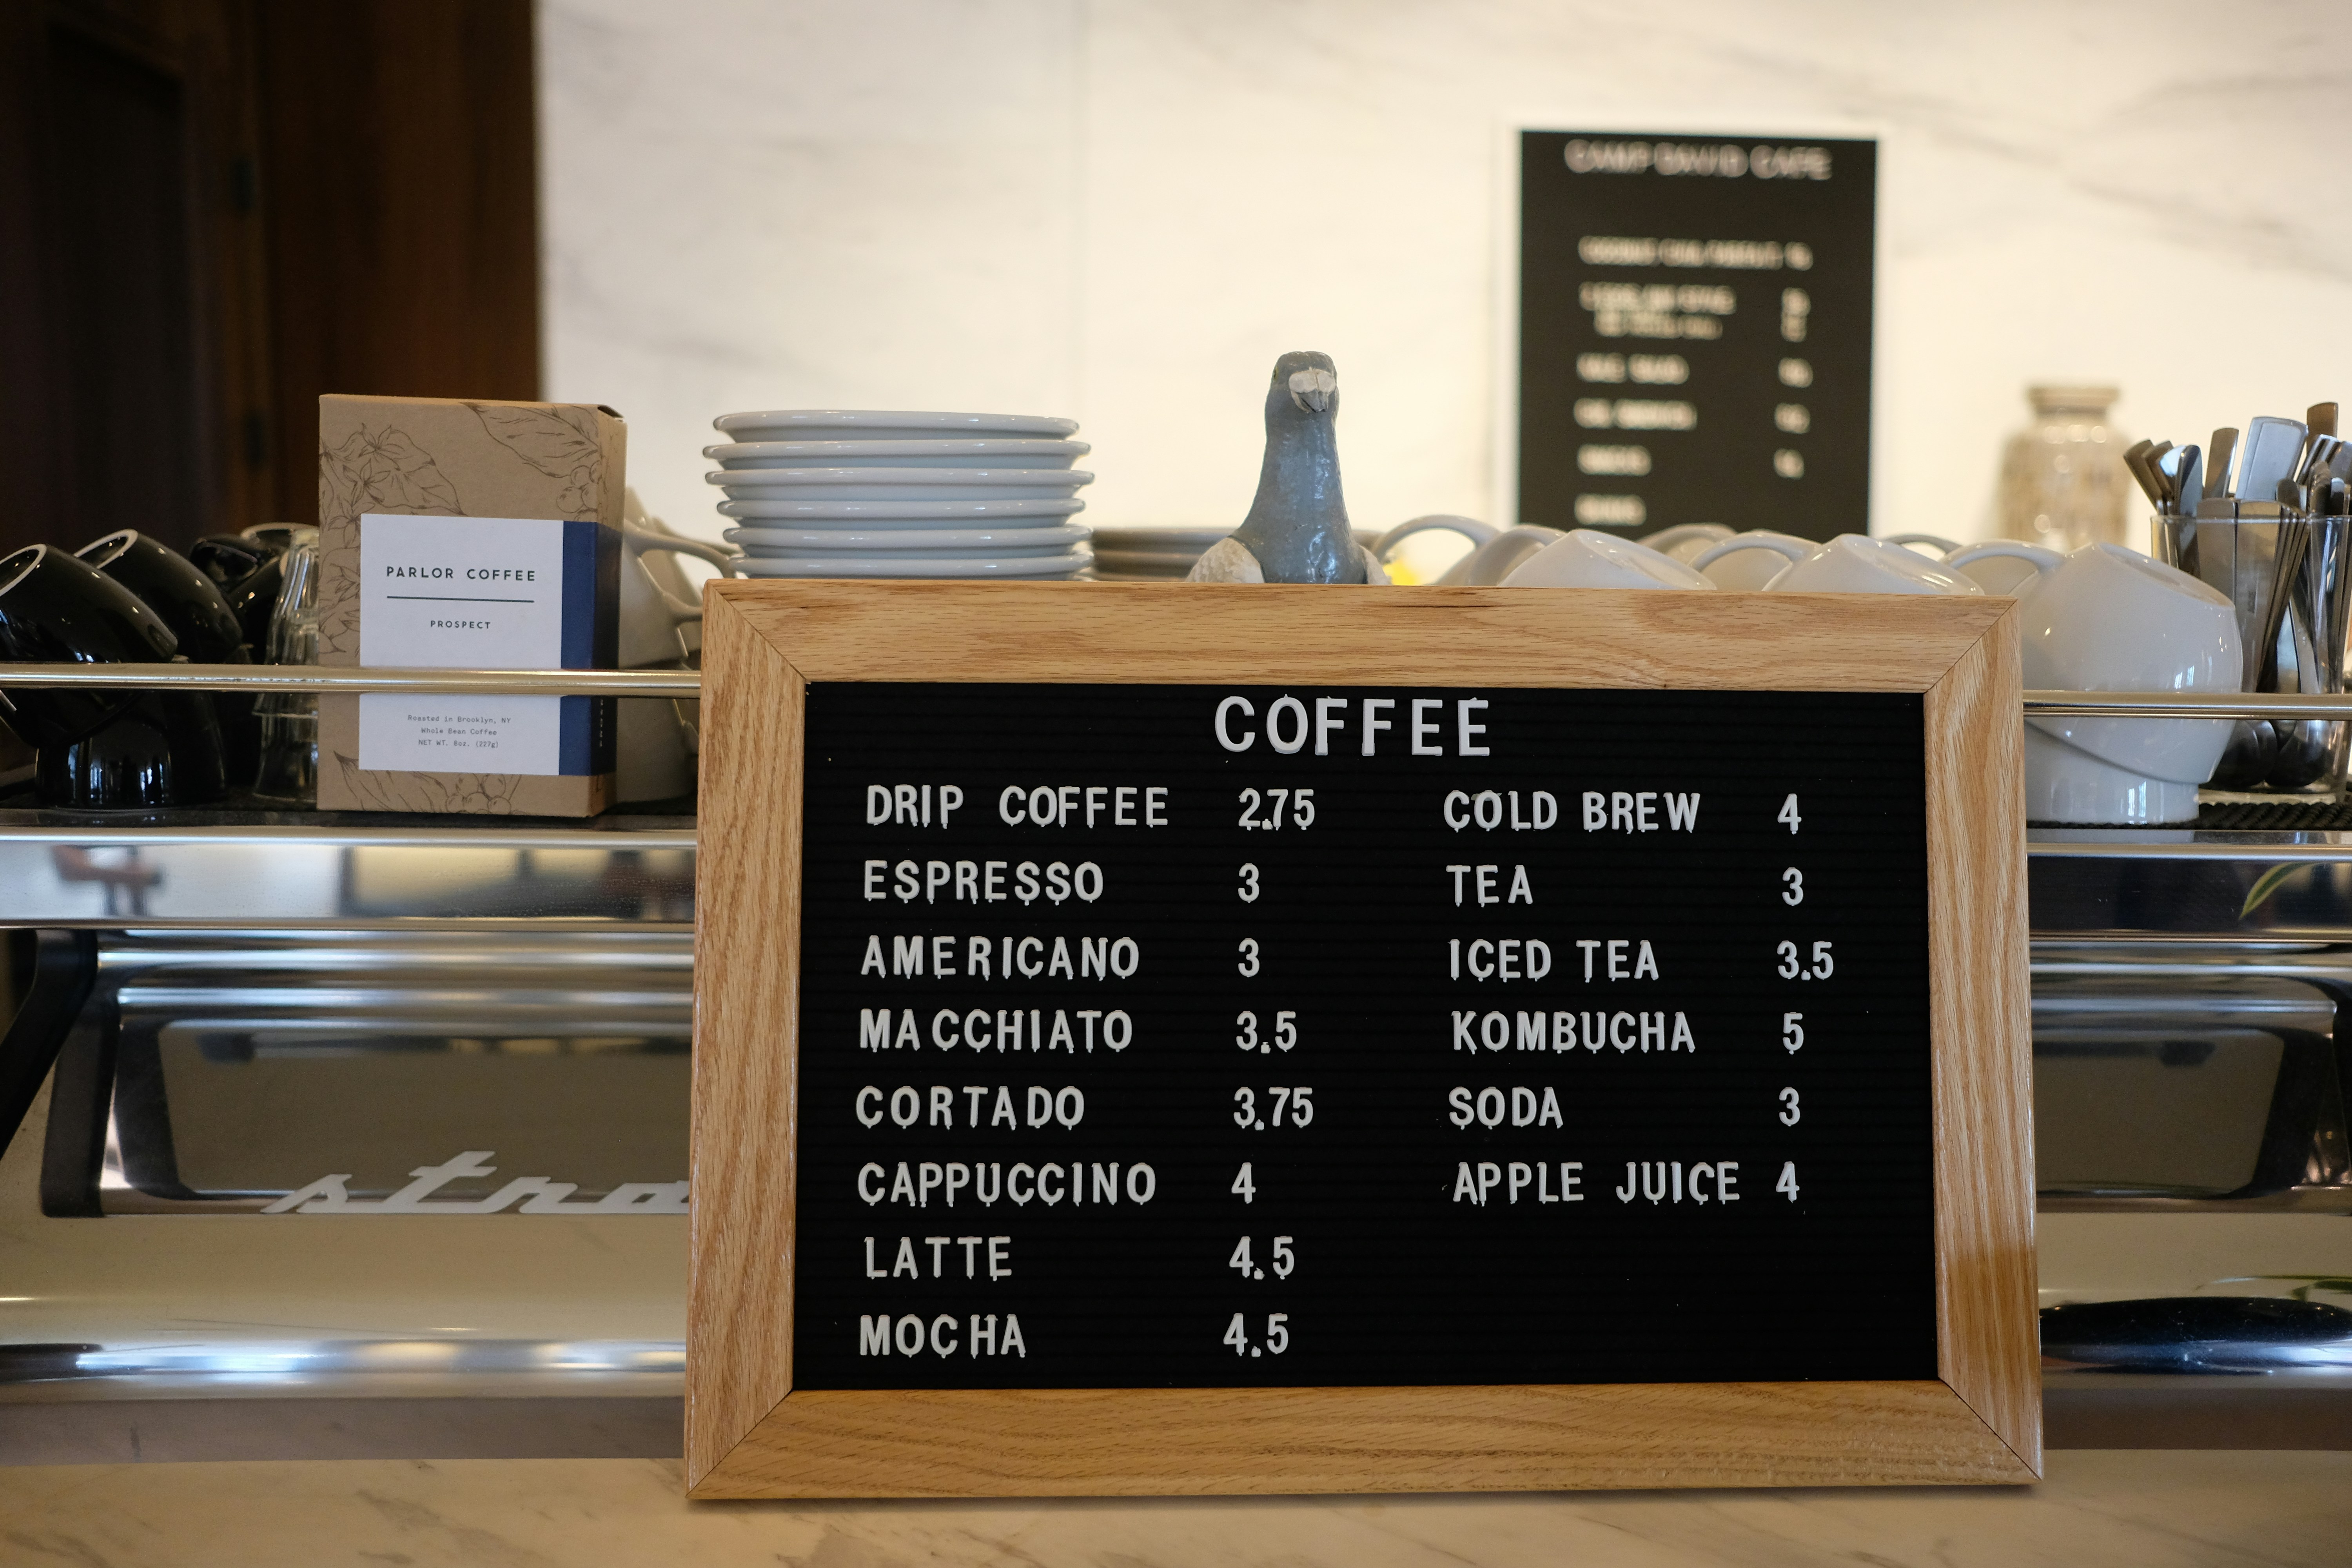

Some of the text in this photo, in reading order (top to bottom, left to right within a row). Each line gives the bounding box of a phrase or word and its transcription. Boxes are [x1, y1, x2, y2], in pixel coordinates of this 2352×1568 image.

[387, 566, 535, 581] PARLOR COFFEE
[430, 620, 490, 629] PROSPECT
[458, 716, 496, 724] Brooklyn,
[1215, 695, 1492, 756] COFFEE
[867, 784, 1314, 831] DRIP COFFEE 2.75
[1444, 790, 1801, 835] COLD BREW 4
[865, 860, 1259, 906] ESPRESSO 3
[1446, 865, 1803, 907] TEA 3
[861, 935, 1259, 981] AMERICANO 3
[1449, 939, 1833, 983] ICED TEA 3.5
[860, 1009, 1297, 1053] MACCHIATO 3.5
[1452, 1011, 1804, 1054] KOMBUCHA 5
[856, 1086, 1313, 1130] CORTADO 3.75
[1449, 1087, 1800, 1130] SODA 3
[858, 1162, 1256, 1207] CAPPUCCINO 4
[1453, 1161, 1799, 1206] APPLE JUICE 4
[864, 1236, 1294, 1281] LATTE 4.5
[860, 1313, 1288, 1359] MOCHA 4.5
